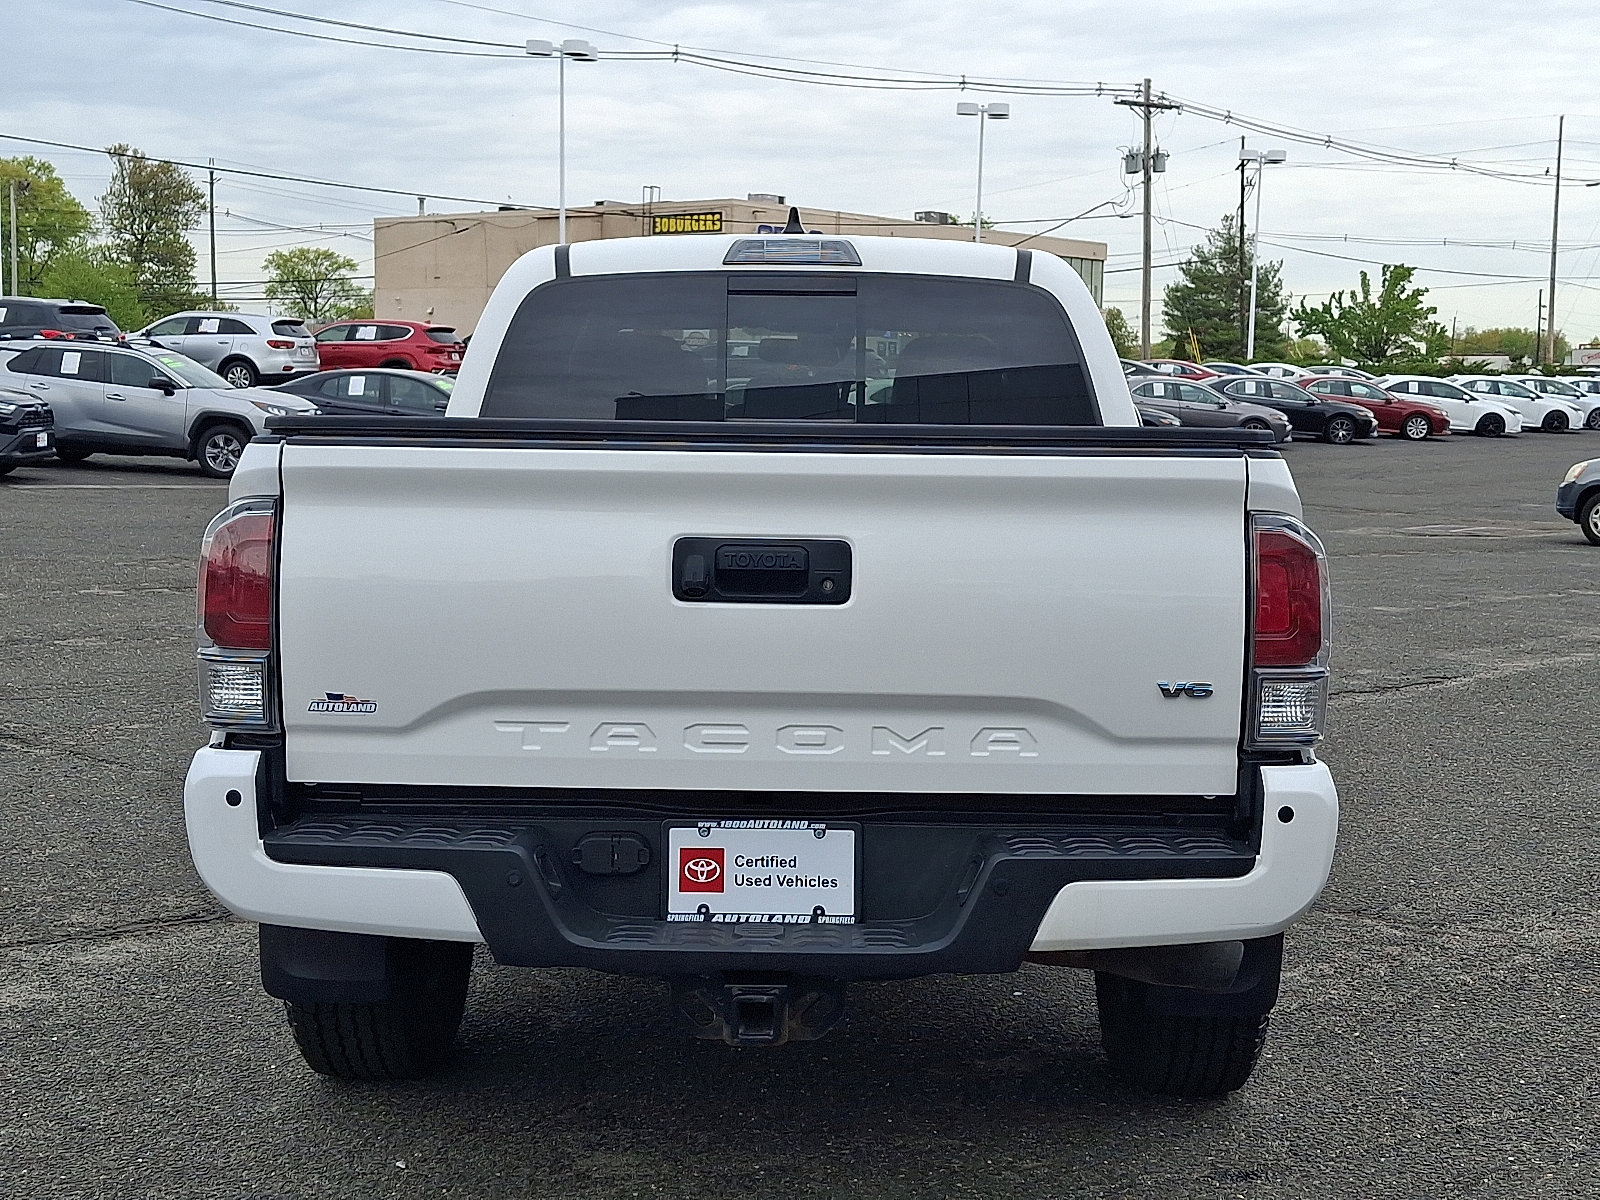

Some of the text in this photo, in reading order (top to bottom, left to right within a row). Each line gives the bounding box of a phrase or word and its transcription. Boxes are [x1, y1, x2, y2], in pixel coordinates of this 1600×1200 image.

[724, 552, 801, 569] TOYOTA
[1157, 680, 1214, 698] V6
[309, 702, 376, 712] AUTOLAND
[493, 720, 1039, 757] TACOMA
[734, 854, 797, 869] Certified
[734, 874, 839, 888] Used Vehicles
[666, 913, 856, 925] SPRINGFIELD AUTOLAND SPRINGFIELD
